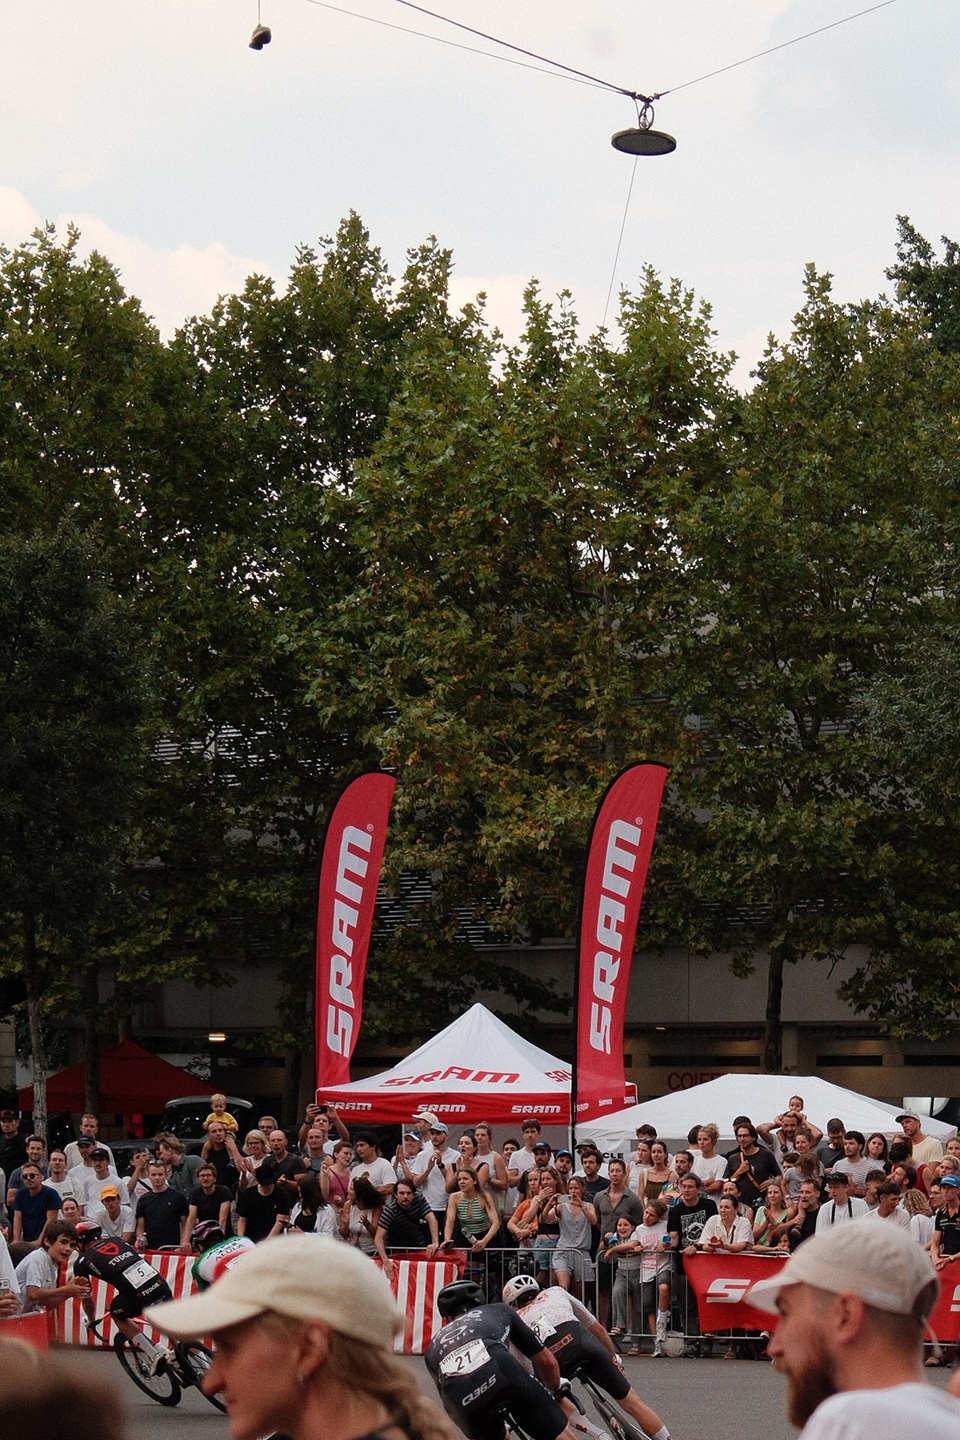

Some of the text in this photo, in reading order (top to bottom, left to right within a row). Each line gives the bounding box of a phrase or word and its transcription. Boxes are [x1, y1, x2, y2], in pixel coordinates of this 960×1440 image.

[327, 825, 373, 1059] SRAM
[590, 818, 642, 1055] SRAM
[379, 1065, 520, 1088] SRAM
[416, 1104, 467, 1113] SRAM
[511, 1104, 561, 1114] SRAM
[108, 1251, 134, 1267] TUDOR
[137, 1267, 146, 1279] 5
[141, 1281, 161, 1297] TUDOR
[455, 1350, 472, 1372] 21
[461, 1373, 497, 1407] Q36.5
